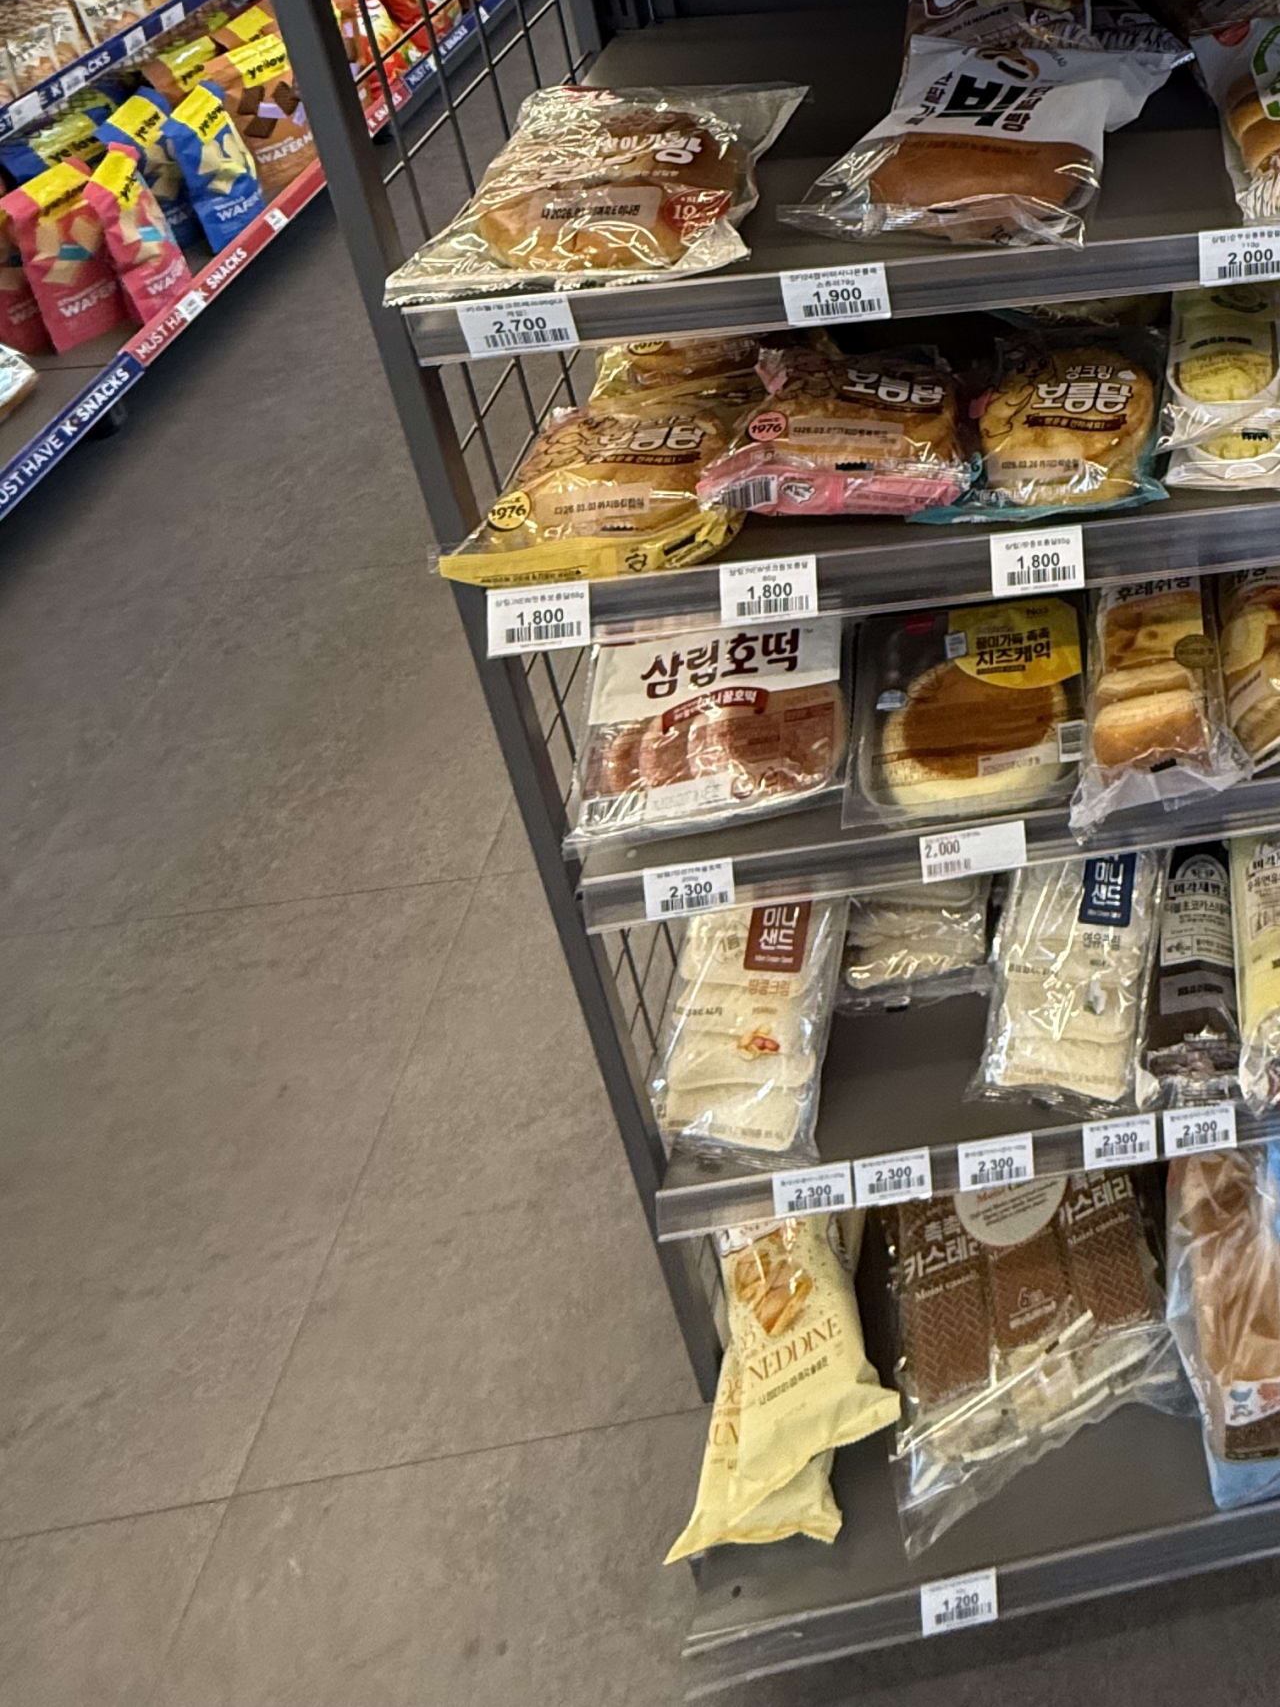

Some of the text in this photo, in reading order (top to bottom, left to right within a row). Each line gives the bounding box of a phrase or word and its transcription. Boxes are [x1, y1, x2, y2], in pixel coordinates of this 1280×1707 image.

[1227, 248, 1274, 266] 2,000
[205, 246, 248, 291] SNACKS
[812, 287, 863, 303] 1,900
[491, 316, 548, 334] 2,700
[1064, 365, 1114, 381] 생크림
[843, 367, 944, 405] 보름달
[1031, 381, 1134, 414] 보름달
[22, 433, 65, 482] HAVE
[77, 365, 131, 424] SNACKS
[751, 422, 783, 435] 1976
[489, 504, 527, 520] 1976
[1016, 553, 1061, 571] 1,800
[746, 583, 793, 600] 1,800
[516, 608, 565, 626] 1,800
[640, 626, 800, 700] 삼립호떡
[975, 642, 1051, 667] 치즈케익
[924, 840, 961, 858] 2,000
[1095, 862, 1125, 886] 미니
[669, 881, 713, 898] 2,300
[1090, 885, 1123, 906] 샌드
[762, 905, 799, 929] 미니
[758, 928, 795, 952] 샌드
[1182, 1121, 1218, 1136] 2,300
[1102, 1131, 1138, 1146] 2,300
[875, 1165, 912, 1181] 2,300
[978, 1156, 1014, 1172] 2,300
[794, 1183, 832, 1199] 2,300
